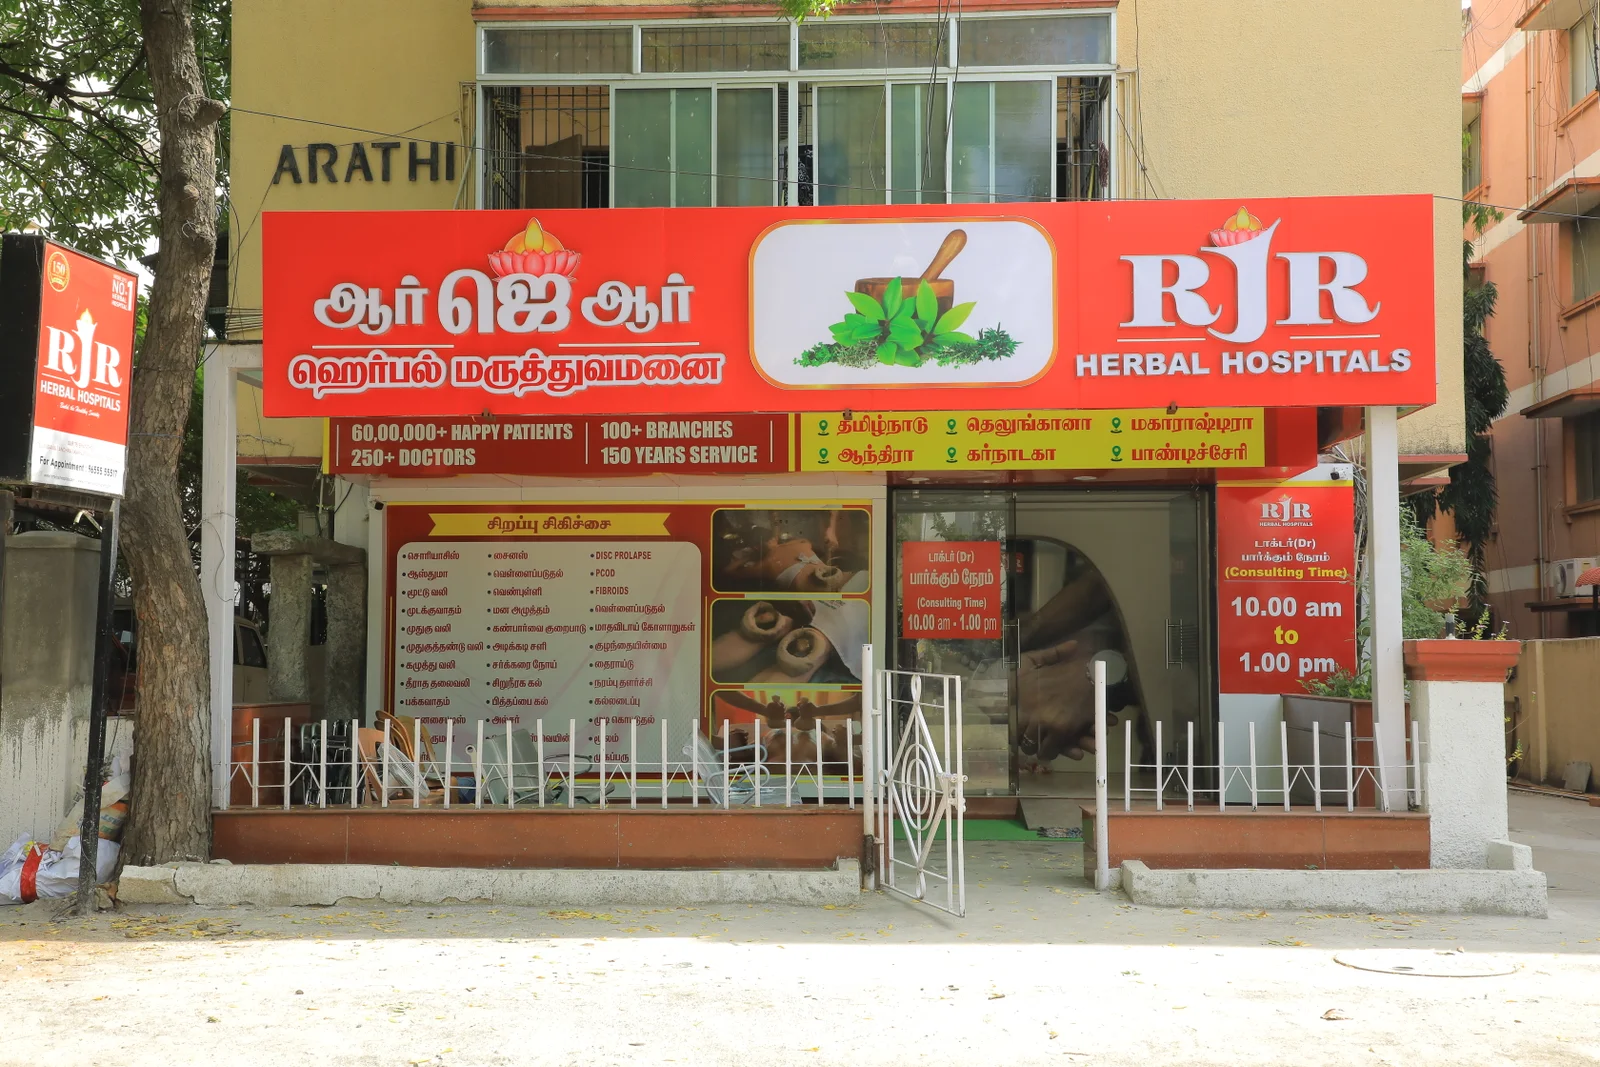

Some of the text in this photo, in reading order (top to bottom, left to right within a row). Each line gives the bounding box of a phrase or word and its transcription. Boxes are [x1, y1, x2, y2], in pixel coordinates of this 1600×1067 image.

[273, 142, 455, 184] ARATHI
[1119, 217, 1381, 343] RJR
[313, 269, 695, 335] ஆர் ஜெ ஆர்
[43, 320, 122, 388] RJR
[1075, 348, 1412, 377] HERBAL HOSPITALS
[290, 350, 724, 396] ஹெர்பல் மருத்துவமனை
[40, 380, 120, 412] HERBAL HOSPITALS
[601, 421, 733, 439] 100+ BRANCHES
[837, 414, 929, 436] தமிழ்நாடு
[967, 413, 1093, 436] தெலுங்கானா
[1131, 412, 1254, 433] மகாராஷ்டிரா
[351, 423, 573, 443] 60,00,000+ HAPPY PATIENTS
[351, 448, 476, 466] 250+ DOCTORS
[601, 445, 758, 464] 150 YEARS SERVICE
[838, 443, 915, 465] ஆந்திரா
[967, 443, 1056, 465] கர்நாடகா
[1131, 442, 1247, 464] பாண்டிச்சேரி
[39, 456, 49, 465] For
[50, 459, 84, 472] Appointment
[1260, 497, 1312, 521] RJR
[487, 515, 611, 534] சிறப்பு சிகிச்சை
[494, 551, 528, 560] சைனஸ்
[596, 551, 652, 560] DISC PROLAPSE
[929, 550, 975, 563] டாக்டர் (Dr)
[1241, 551, 1331, 563] பார்க்கும் நேரம்
[407, 568, 448, 581] ஆஸ்துமா
[493, 569, 564, 579] வெள்ளைப்படுதல்
[596, 569, 616, 577] PCOD
[910, 568, 994, 590] பார்க்கும் நேரம்
[1225, 567, 1348, 579] (Consulting Time)
[431, 587, 448, 596] வலி
[595, 586, 629, 595] FIBROIDS
[493, 606, 509, 615] மன
[917, 597, 987, 610] (Consulting Time)
[1231, 596, 1342, 617] 10.00 am
[435, 623, 452, 633] வலி
[908, 613, 935, 631] 10.00
[937, 617, 951, 631] am
[960, 613, 981, 631] 1.00
[984, 617, 997, 634] pm
[1274, 625, 1299, 645] to
[467, 641, 484, 651] வலி
[530, 641, 547, 651] சளி
[439, 660, 456, 669] வலி
[492, 659, 557, 671] சர்க்கரை நோய்
[1239, 652, 1336, 677] 1.00 pm
[430, 677, 471, 689] தலைவலி
[528, 678, 543, 688] கல்
[594, 678, 618, 688] நரம்பு
[405, 696, 451, 708] பக்கவாதம்
[534, 696, 549, 706] கல்
